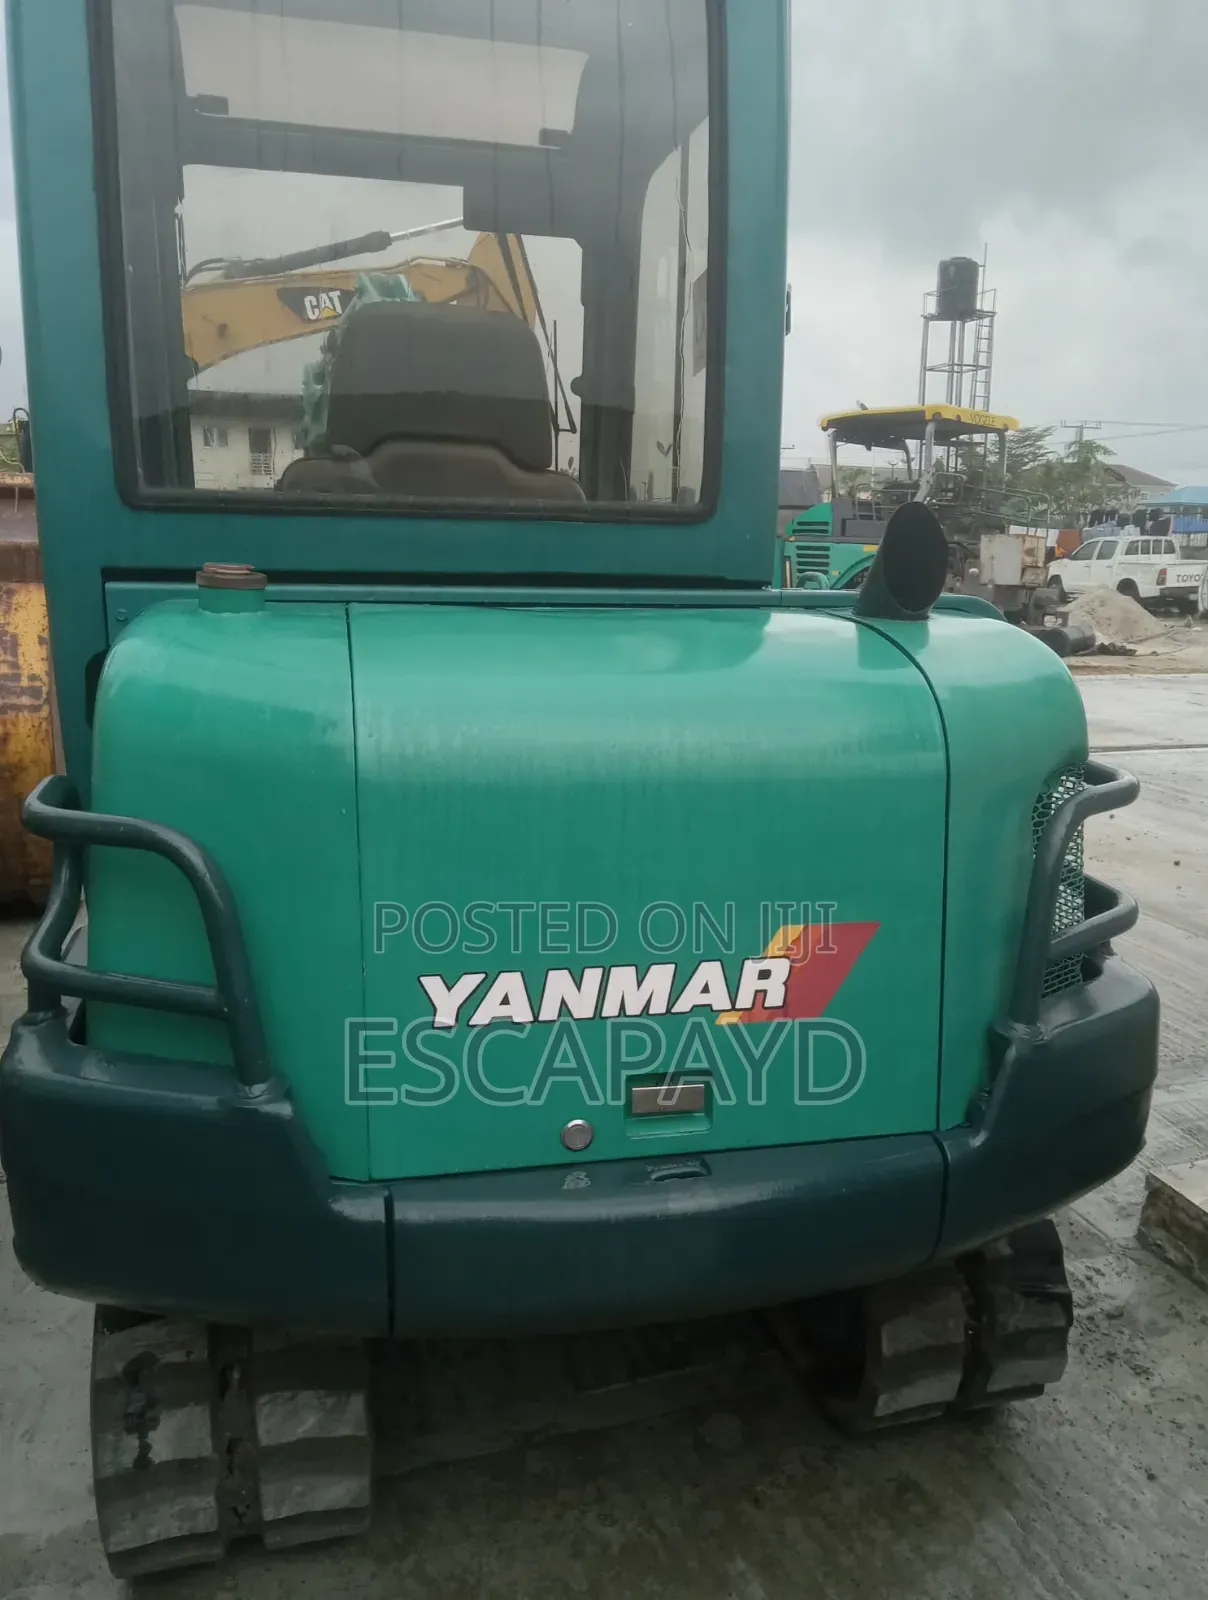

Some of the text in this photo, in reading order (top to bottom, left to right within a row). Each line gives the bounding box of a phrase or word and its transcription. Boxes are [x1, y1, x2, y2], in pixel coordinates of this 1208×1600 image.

[304, 290, 342, 320] CAT
[1176, 573, 1204, 583] TOYO
[418, 957, 792, 1030] YANMAR
